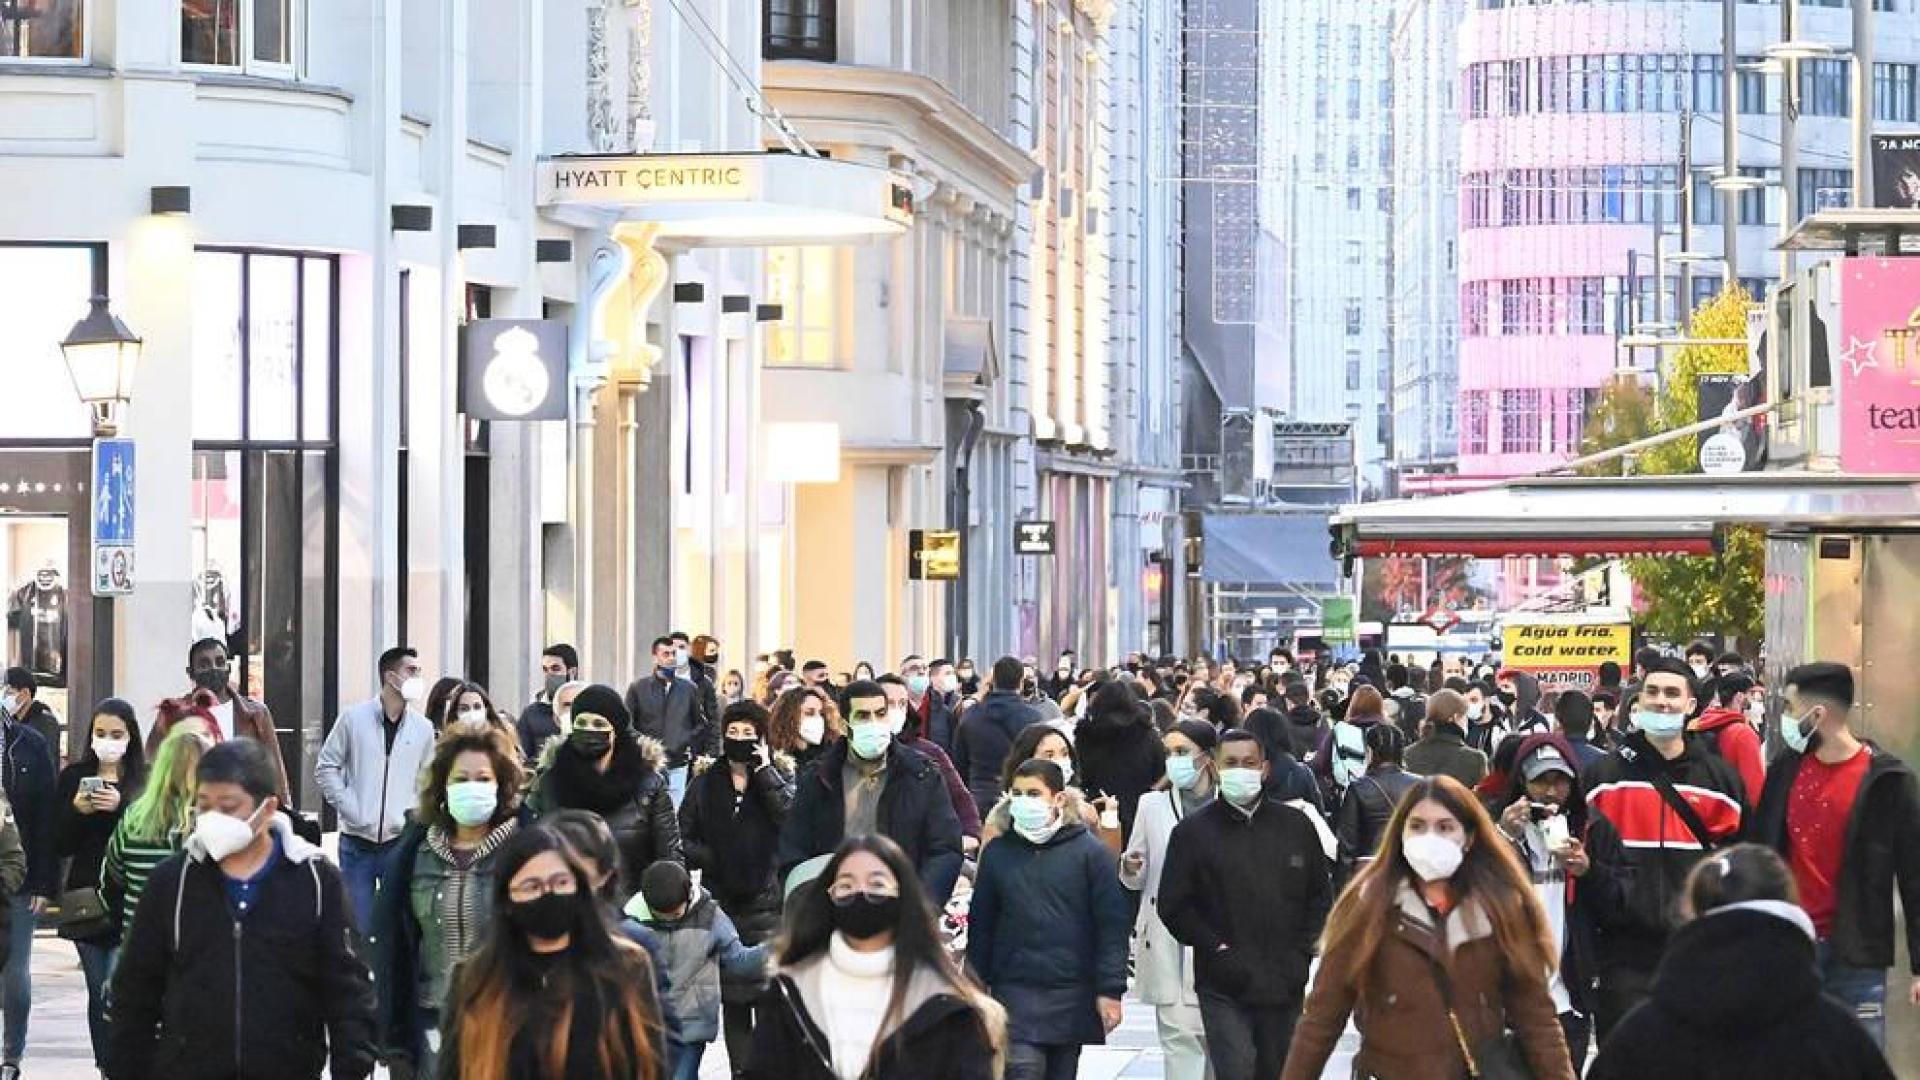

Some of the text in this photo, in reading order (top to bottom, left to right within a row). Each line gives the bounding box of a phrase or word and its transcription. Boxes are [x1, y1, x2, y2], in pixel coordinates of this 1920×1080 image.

[555, 170, 627, 189] HYATT
[1520, 625, 1568, 638] Agua
[1513, 644, 1620, 656] Cold water.
[1537, 671, 1592, 683] MADRID
